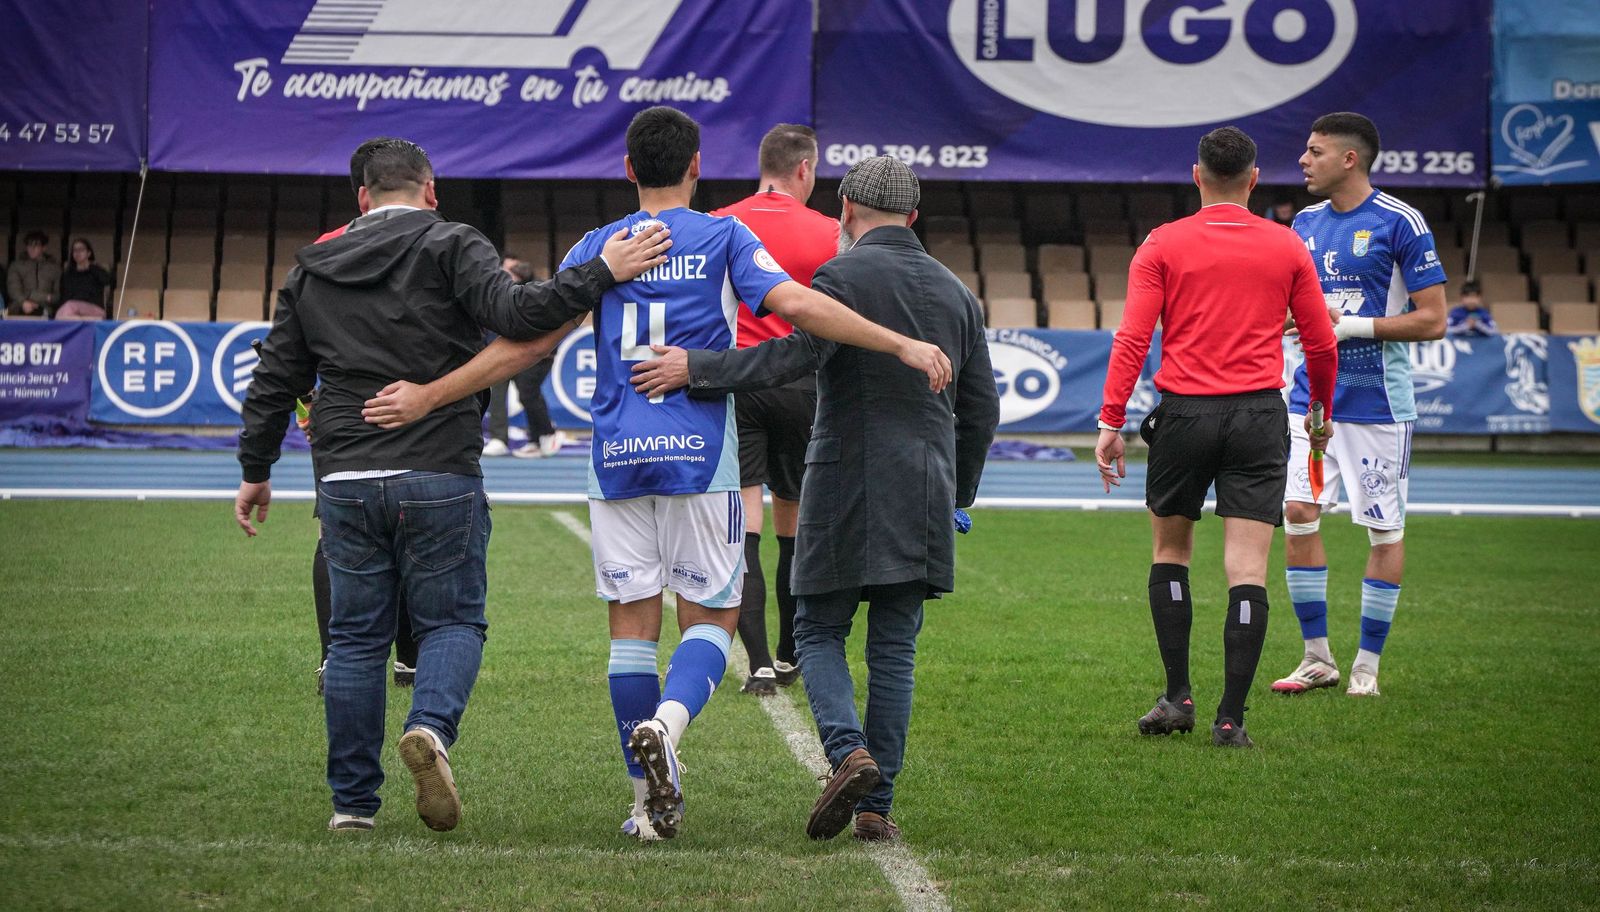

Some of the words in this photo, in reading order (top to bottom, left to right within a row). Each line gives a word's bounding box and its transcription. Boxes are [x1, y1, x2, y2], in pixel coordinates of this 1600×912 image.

[975, 0, 1337, 65] LUGO
[233, 57, 272, 102] Te
[283, 68, 511, 111] acompañamos
[520, 74, 564, 101] en
[572, 64, 609, 109] tu
[619, 71, 732, 103] camino
[18, 122, 47, 142] 47
[55, 123, 80, 143] 53
[88, 123, 114, 143] 57
[939, 145, 988, 168] 823
[1370, 151, 1418, 174] 793
[1423, 151, 1475, 175] 236
[0, 342, 26, 366] 38
[30, 342, 62, 366] 677
[621, 302, 666, 404] 4
[620, 434, 705, 454] JIMANG
[603, 460, 628, 468] Empresa
[628, 455, 664, 466] Aplicadora
[664, 454, 706, 463] Homologada
